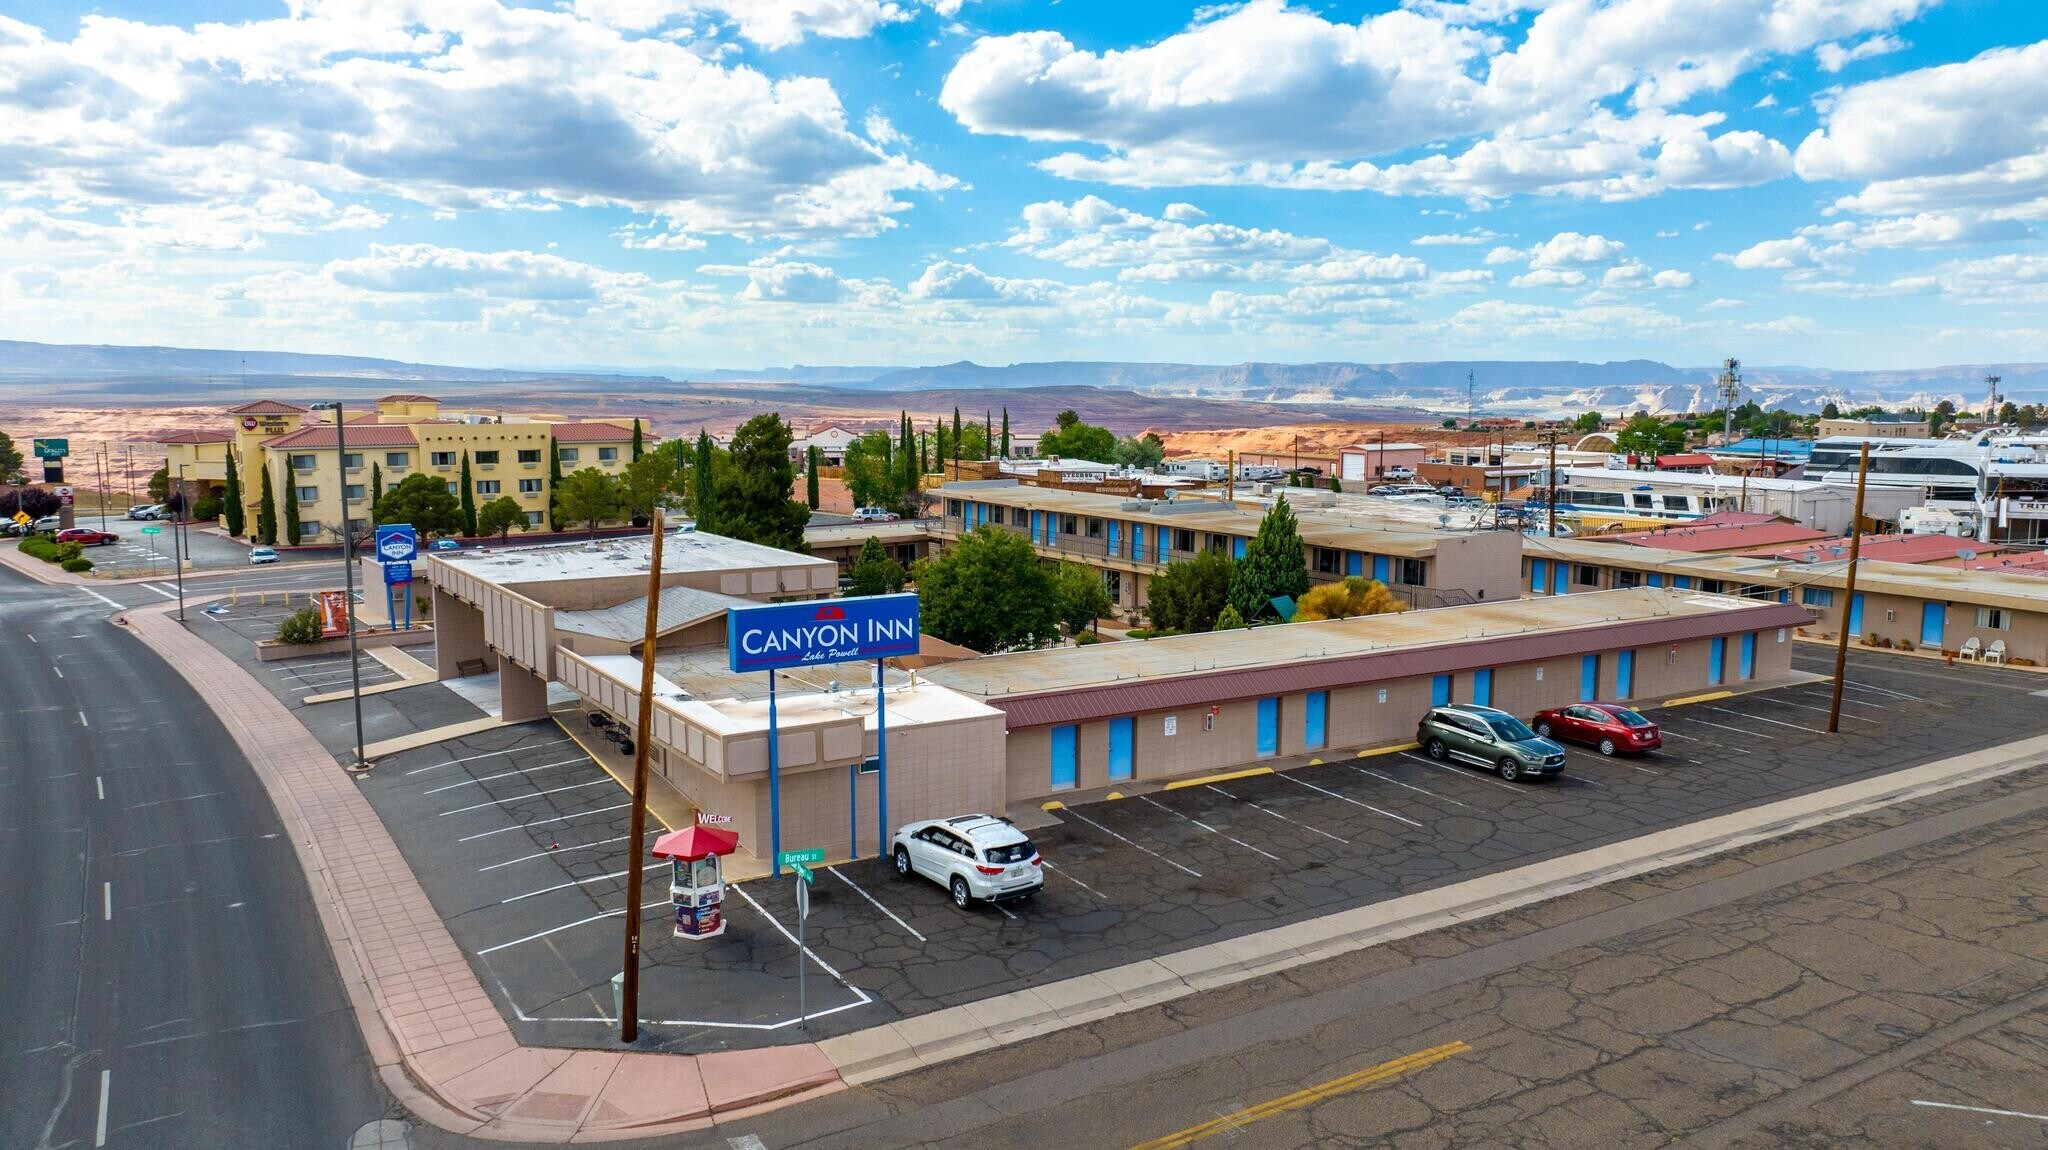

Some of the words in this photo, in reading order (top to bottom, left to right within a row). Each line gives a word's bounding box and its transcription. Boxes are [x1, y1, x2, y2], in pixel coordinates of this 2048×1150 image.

[742, 623, 858, 654] CANYON
[868, 617, 913, 642] INN
[801, 650, 825, 662] Lake
[828, 647, 860, 659] Powell
[698, 813, 733, 824] WELCOME
[785, 853, 810, 863] Bureau
